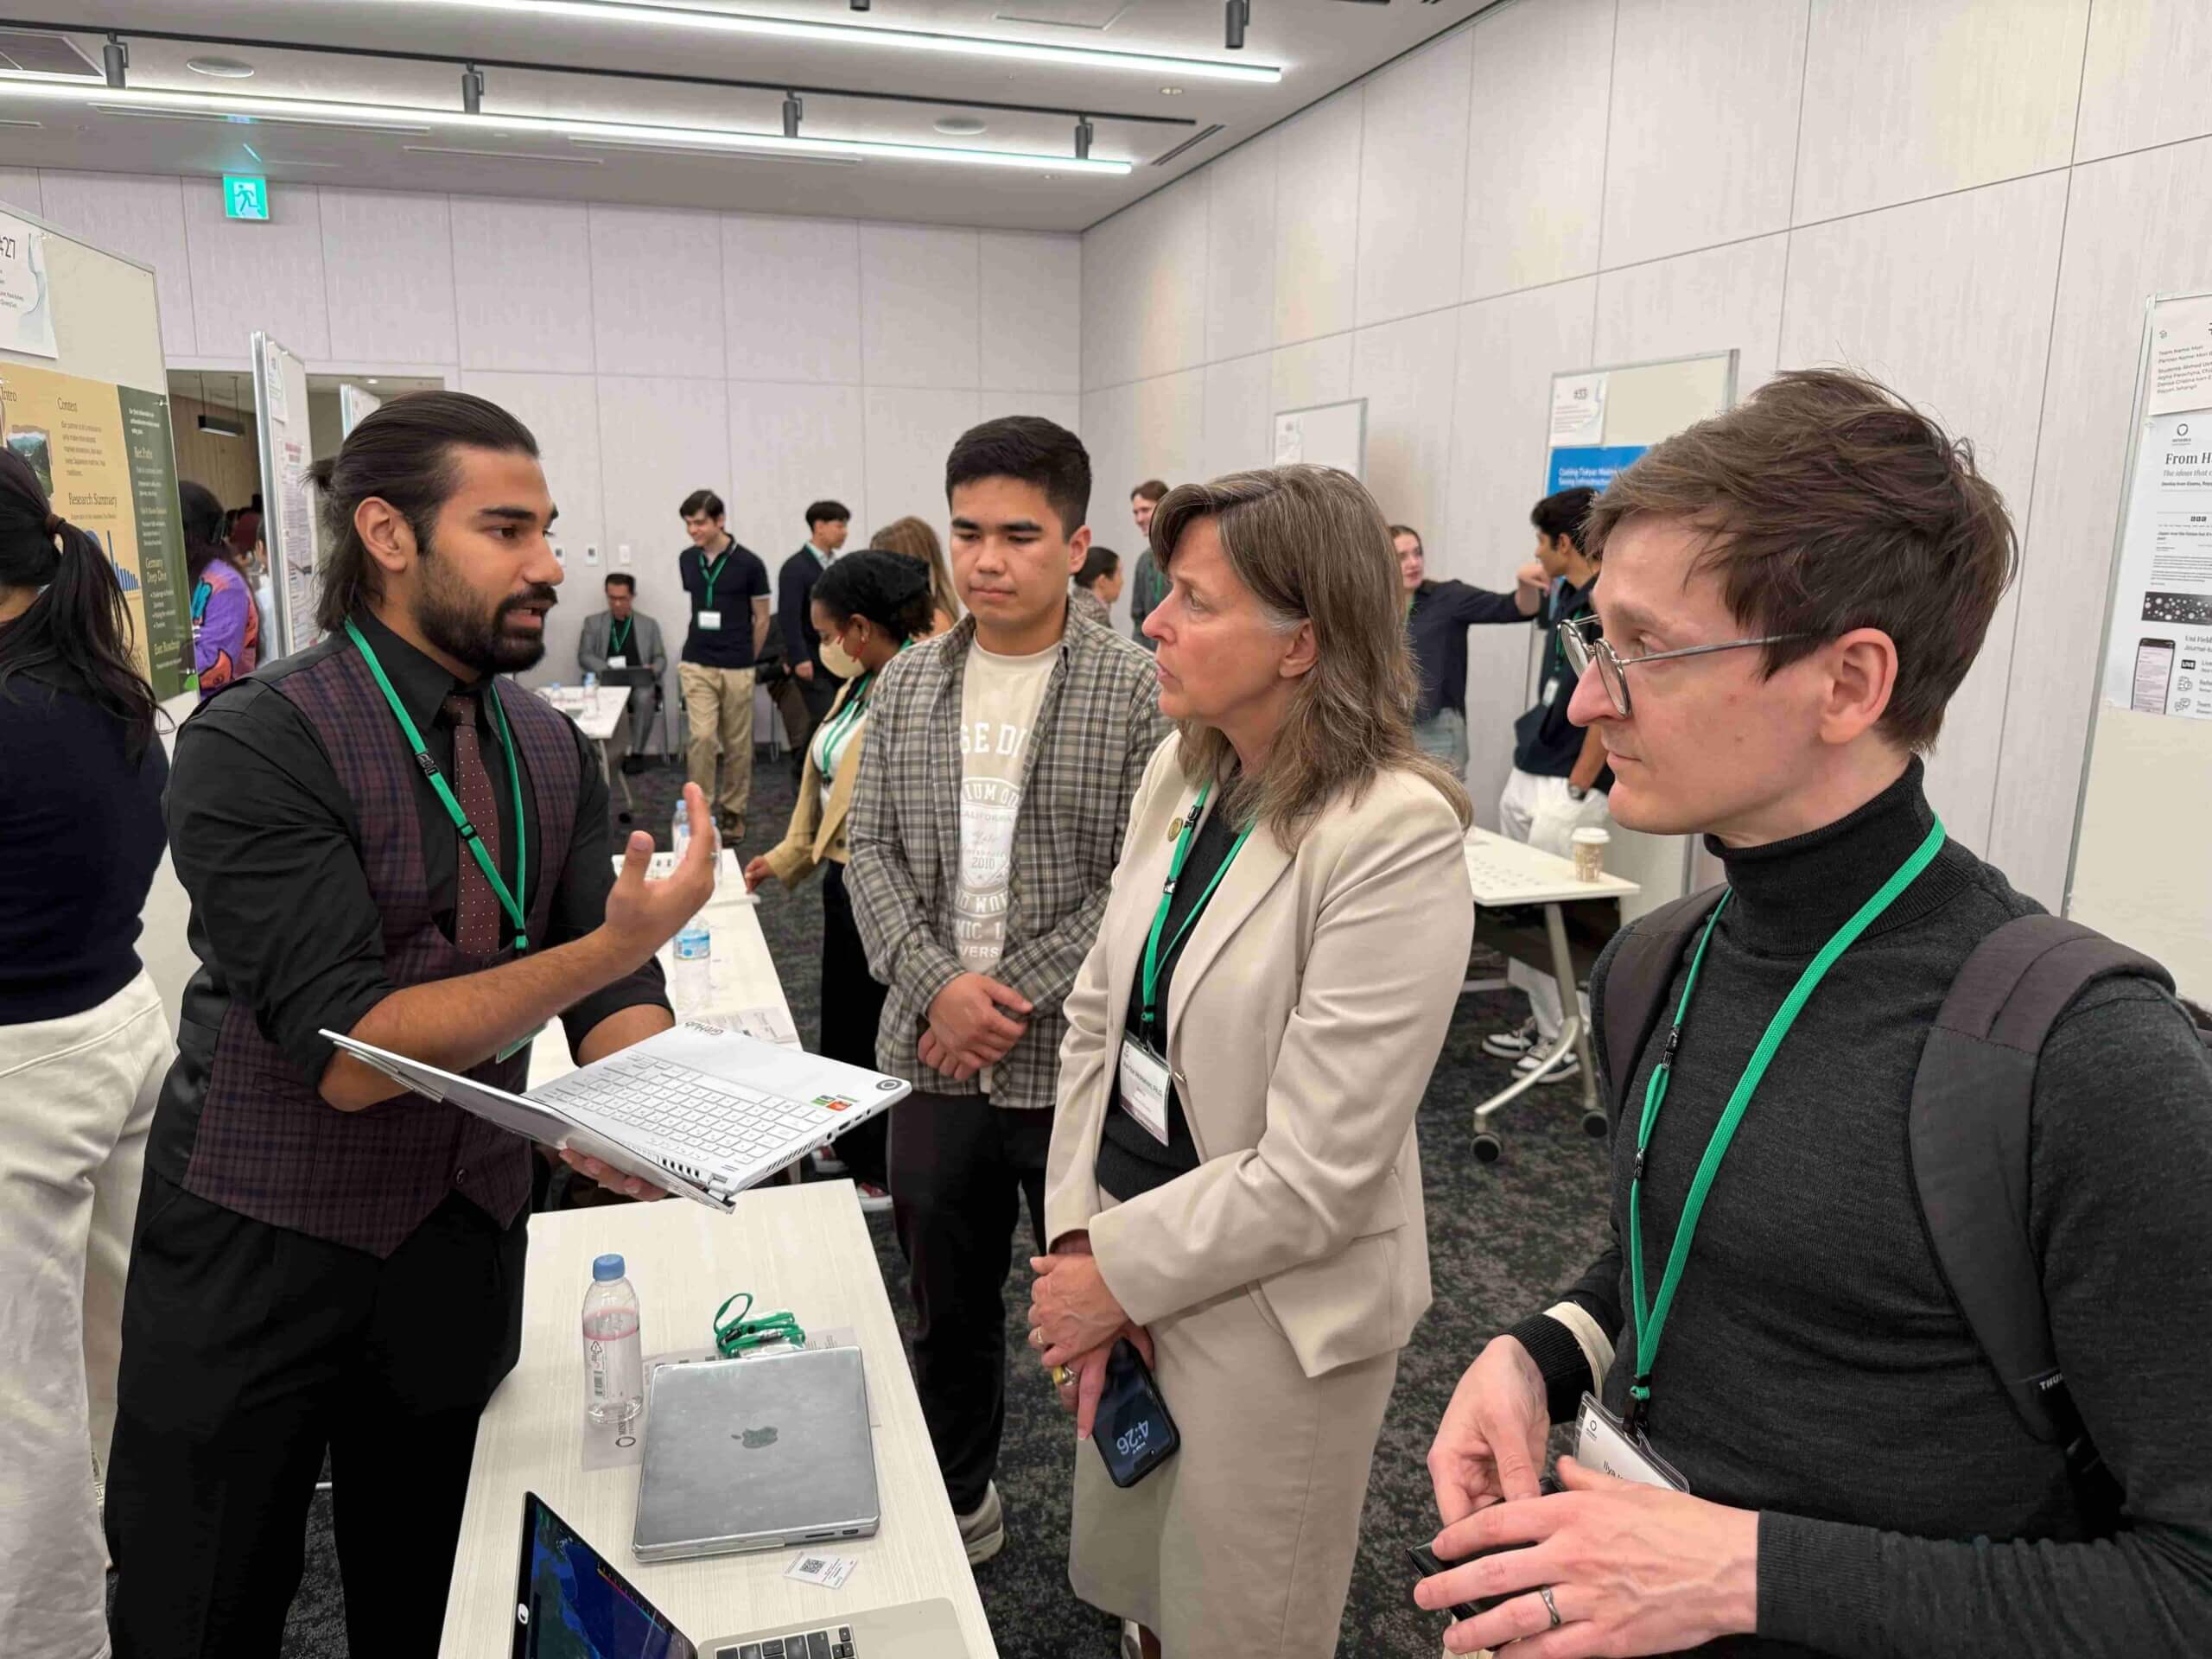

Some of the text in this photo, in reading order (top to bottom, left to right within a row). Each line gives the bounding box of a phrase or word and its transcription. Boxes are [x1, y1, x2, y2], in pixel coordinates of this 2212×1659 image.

[2165, 452, 2212, 465] From H
[68, 492, 93, 505] Research
[1116, 1420, 1149, 1455] 4:26
